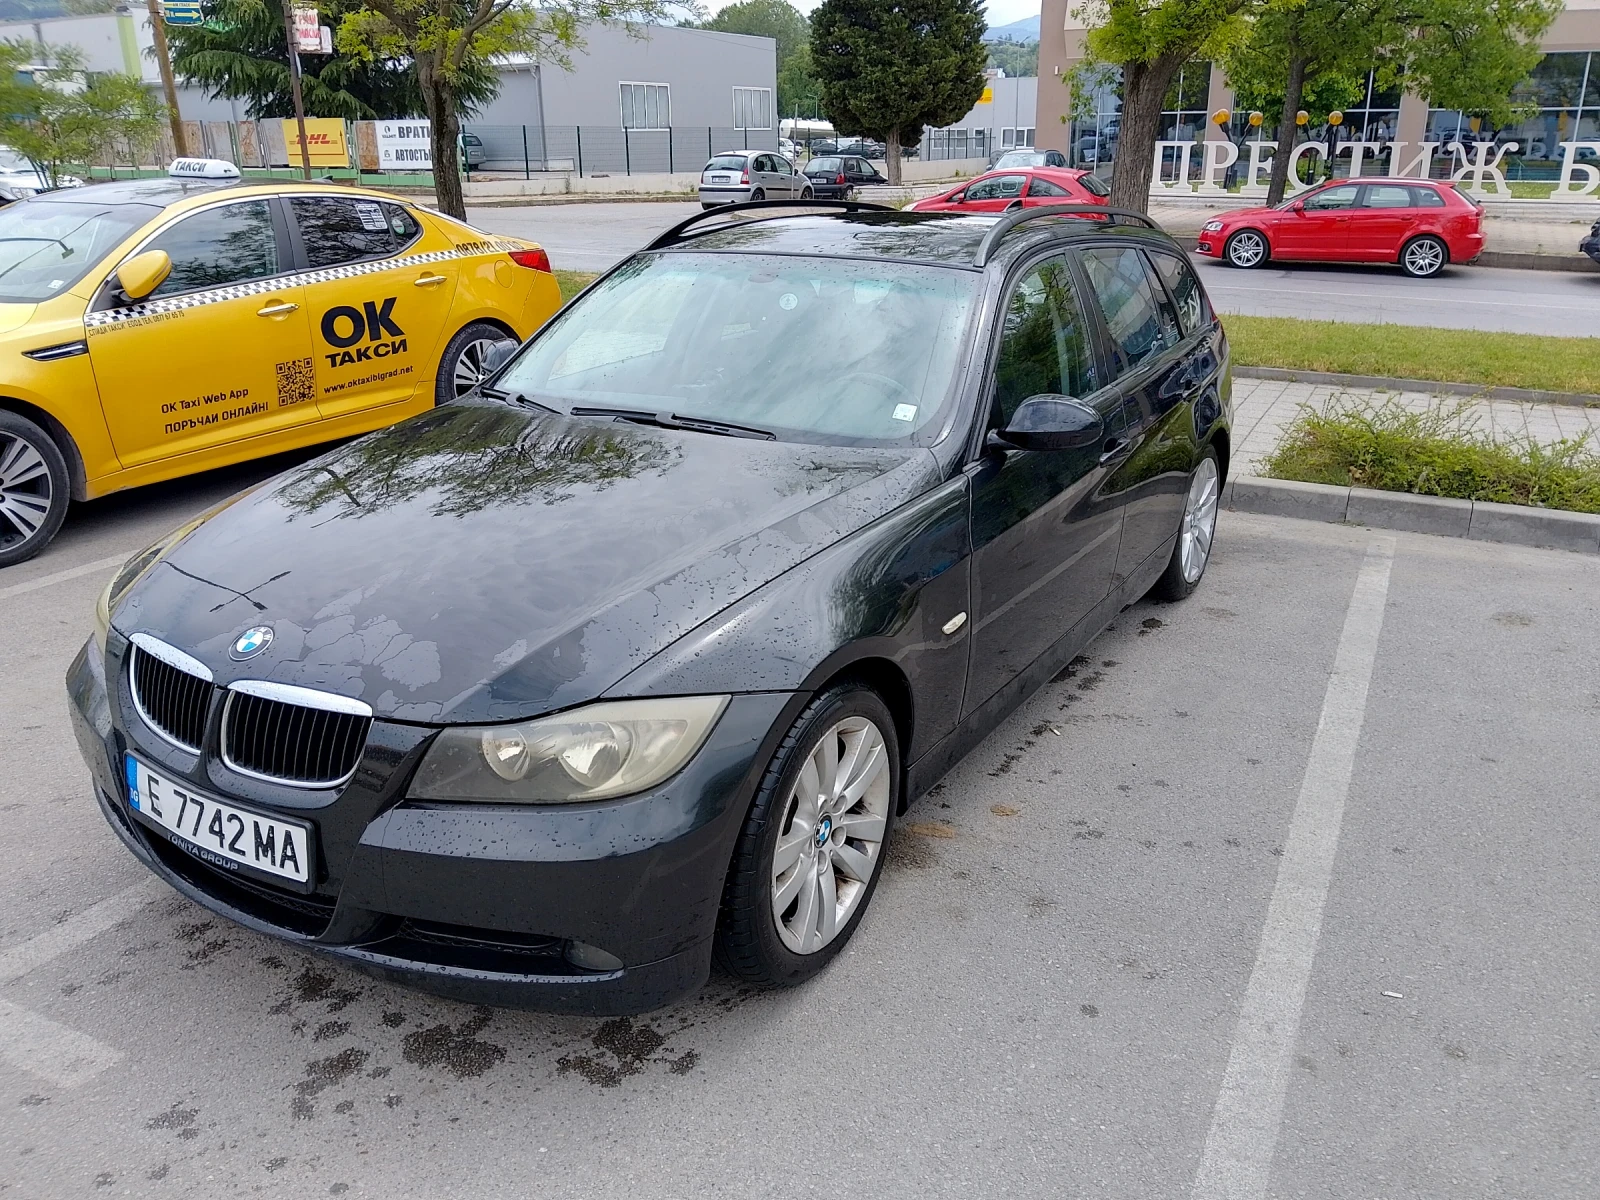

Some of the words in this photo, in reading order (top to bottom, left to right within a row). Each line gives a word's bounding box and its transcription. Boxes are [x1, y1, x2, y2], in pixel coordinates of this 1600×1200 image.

[174, 161, 208, 173] ТАКСИ
[1150, 140, 1520, 196] ПРЕСТИЖ
[1551, 141, 1600, 196] Б
[321, 296, 406, 349] OK
[324, 338, 408, 369] ТАКСИ
[323, 365, 414, 395] www.oktaxiblgrad.net
[161, 402, 178, 414] OK
[179, 397, 201, 410] Taxi
[203, 392, 227, 405] Web
[229, 388, 249, 400] App
[147, 773, 163, 819] E
[172, 790, 246, 858] 7742
[252, 820, 300, 875] MA
[167, 832, 200, 856] TONITA
[200, 850, 239, 870] GROUP
